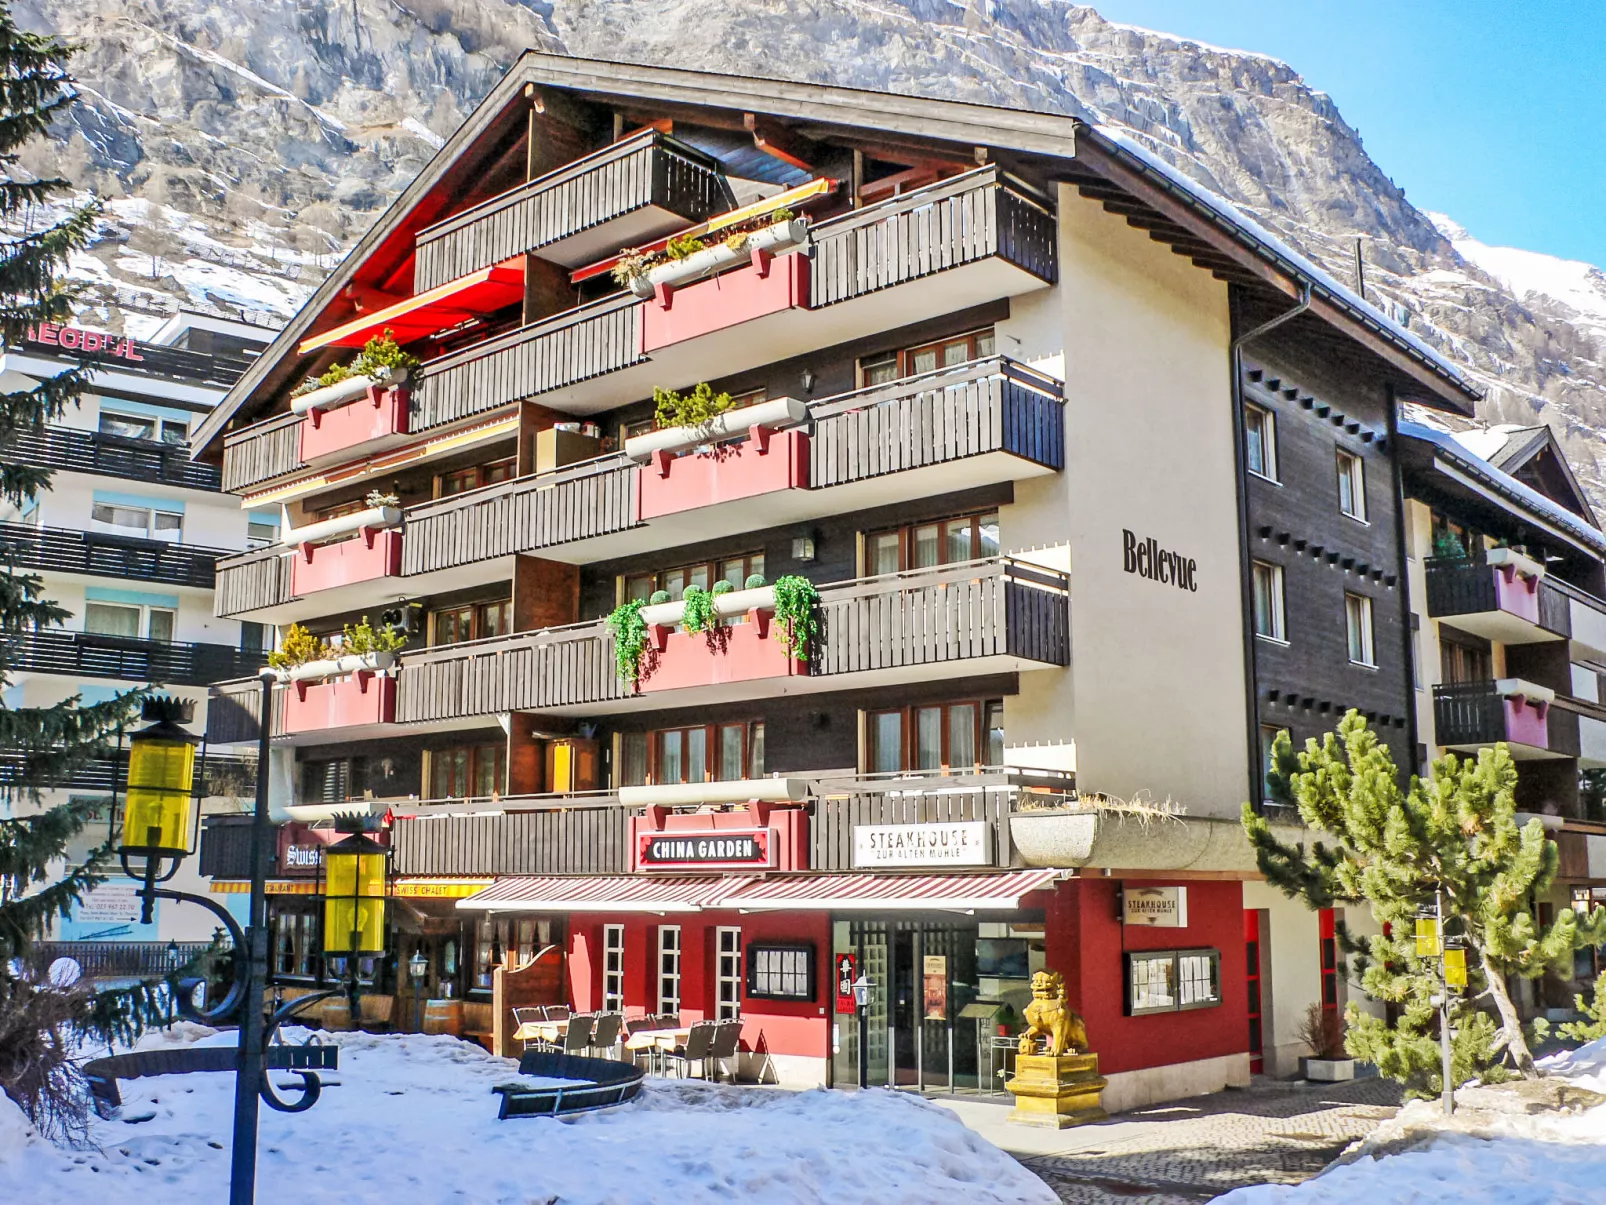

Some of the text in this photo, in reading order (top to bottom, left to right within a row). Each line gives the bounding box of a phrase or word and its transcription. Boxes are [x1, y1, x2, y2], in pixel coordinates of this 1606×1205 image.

[1123, 528, 1197, 592] Bellevue
[870, 830, 968, 849] STEAKHOUSE
[653, 839, 752, 859] CHINA GARDEN
[265, 884, 294, 893] STAURANT
[396, 886, 447, 895] SWISS CHALET
[1128, 900, 1175, 909] STEAKHOUSE
